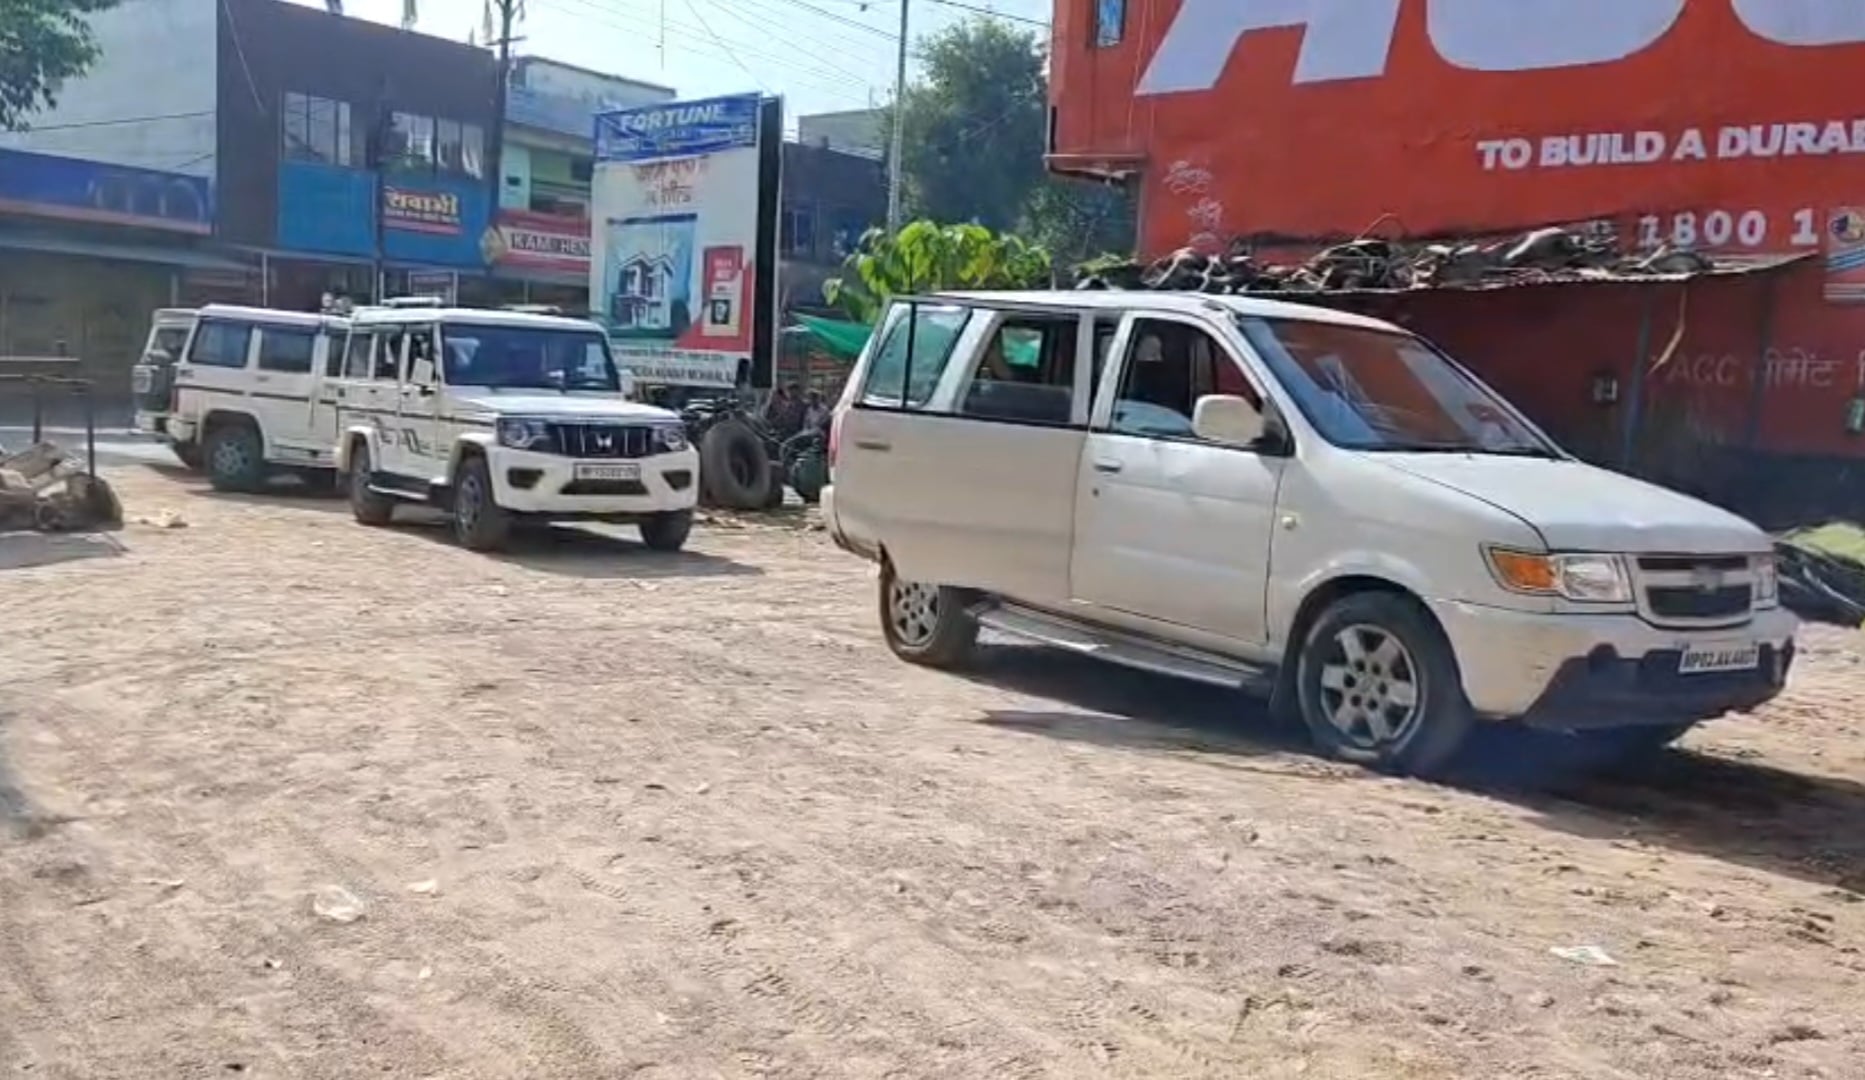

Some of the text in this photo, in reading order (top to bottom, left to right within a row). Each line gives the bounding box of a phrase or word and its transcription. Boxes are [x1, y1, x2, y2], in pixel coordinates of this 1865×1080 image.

[620, 103, 724, 132] FORTUNE
[1477, 139, 1531, 169] TO
[1539, 131, 1666, 167] BUILD
[1672, 128, 1706, 160] A
[1639, 210, 1766, 246] 1800
